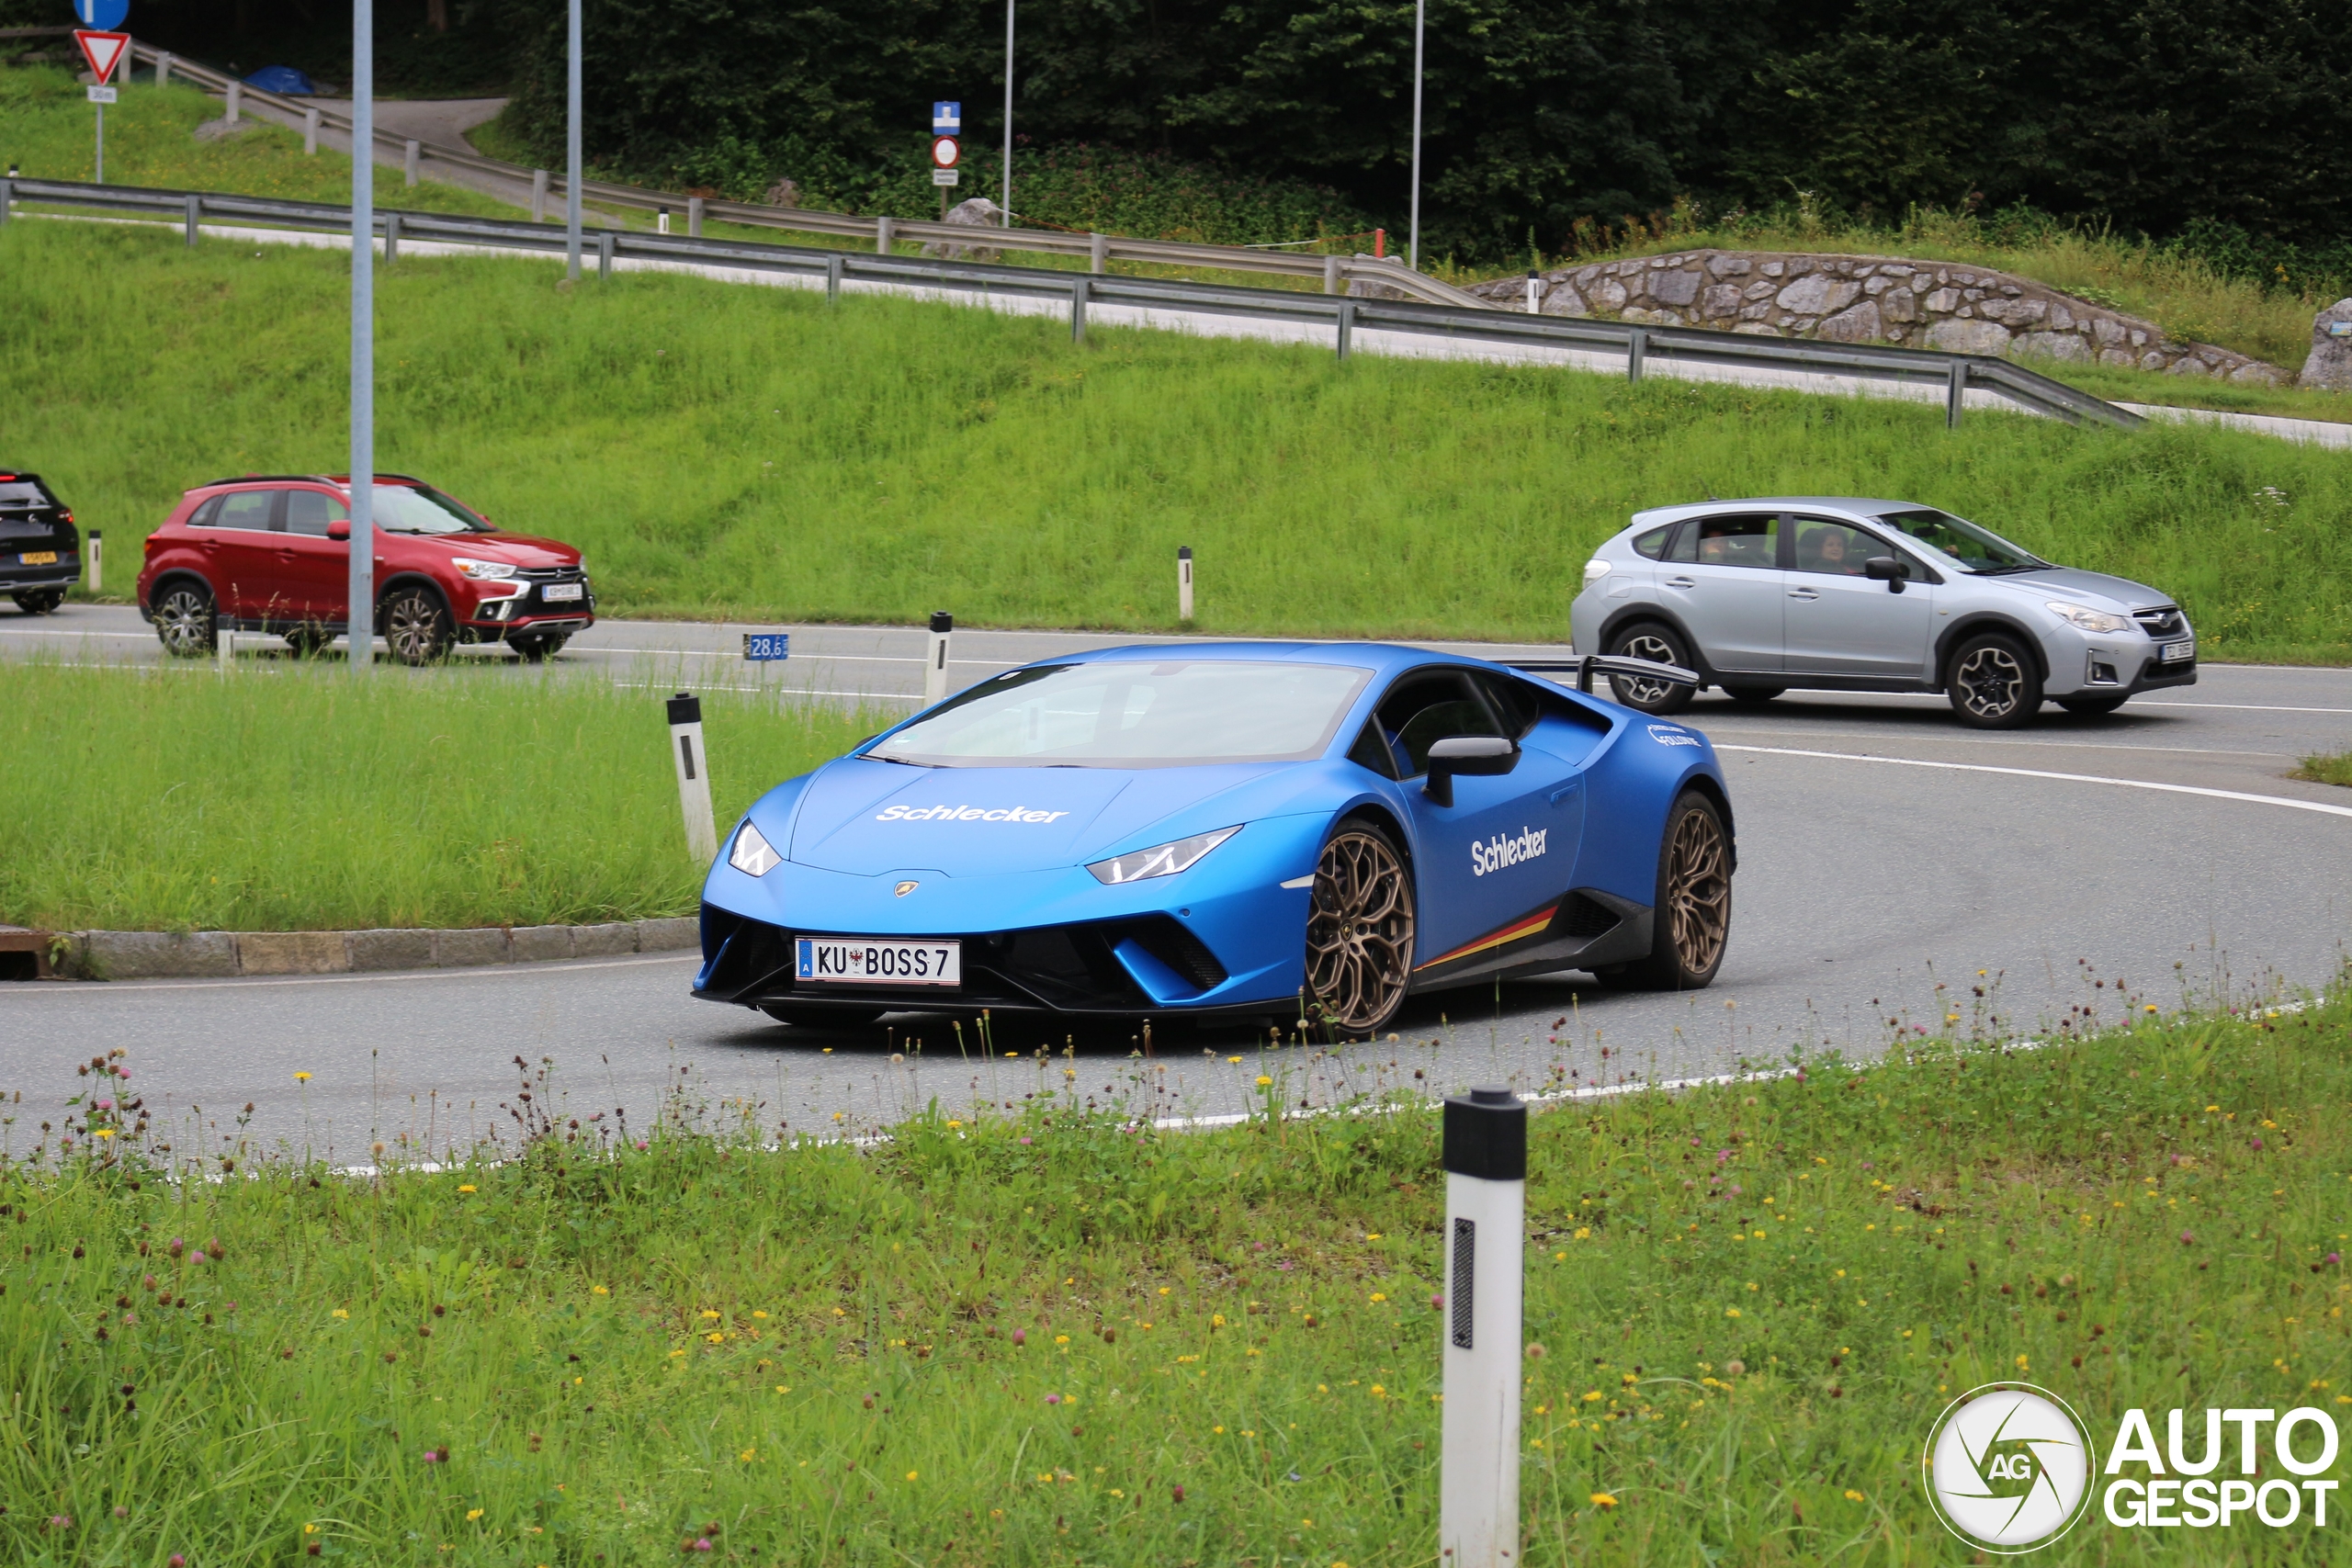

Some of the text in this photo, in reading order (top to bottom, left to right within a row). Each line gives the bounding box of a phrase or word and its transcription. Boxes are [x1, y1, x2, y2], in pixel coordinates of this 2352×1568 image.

[752, 637, 782, 658] 28,6
[876, 805, 1070, 823] Schlecker
[1472, 826, 1547, 876] Schlecker
[802, 963, 809, 973] A
[818, 946, 949, 976] KU BOSS 7
